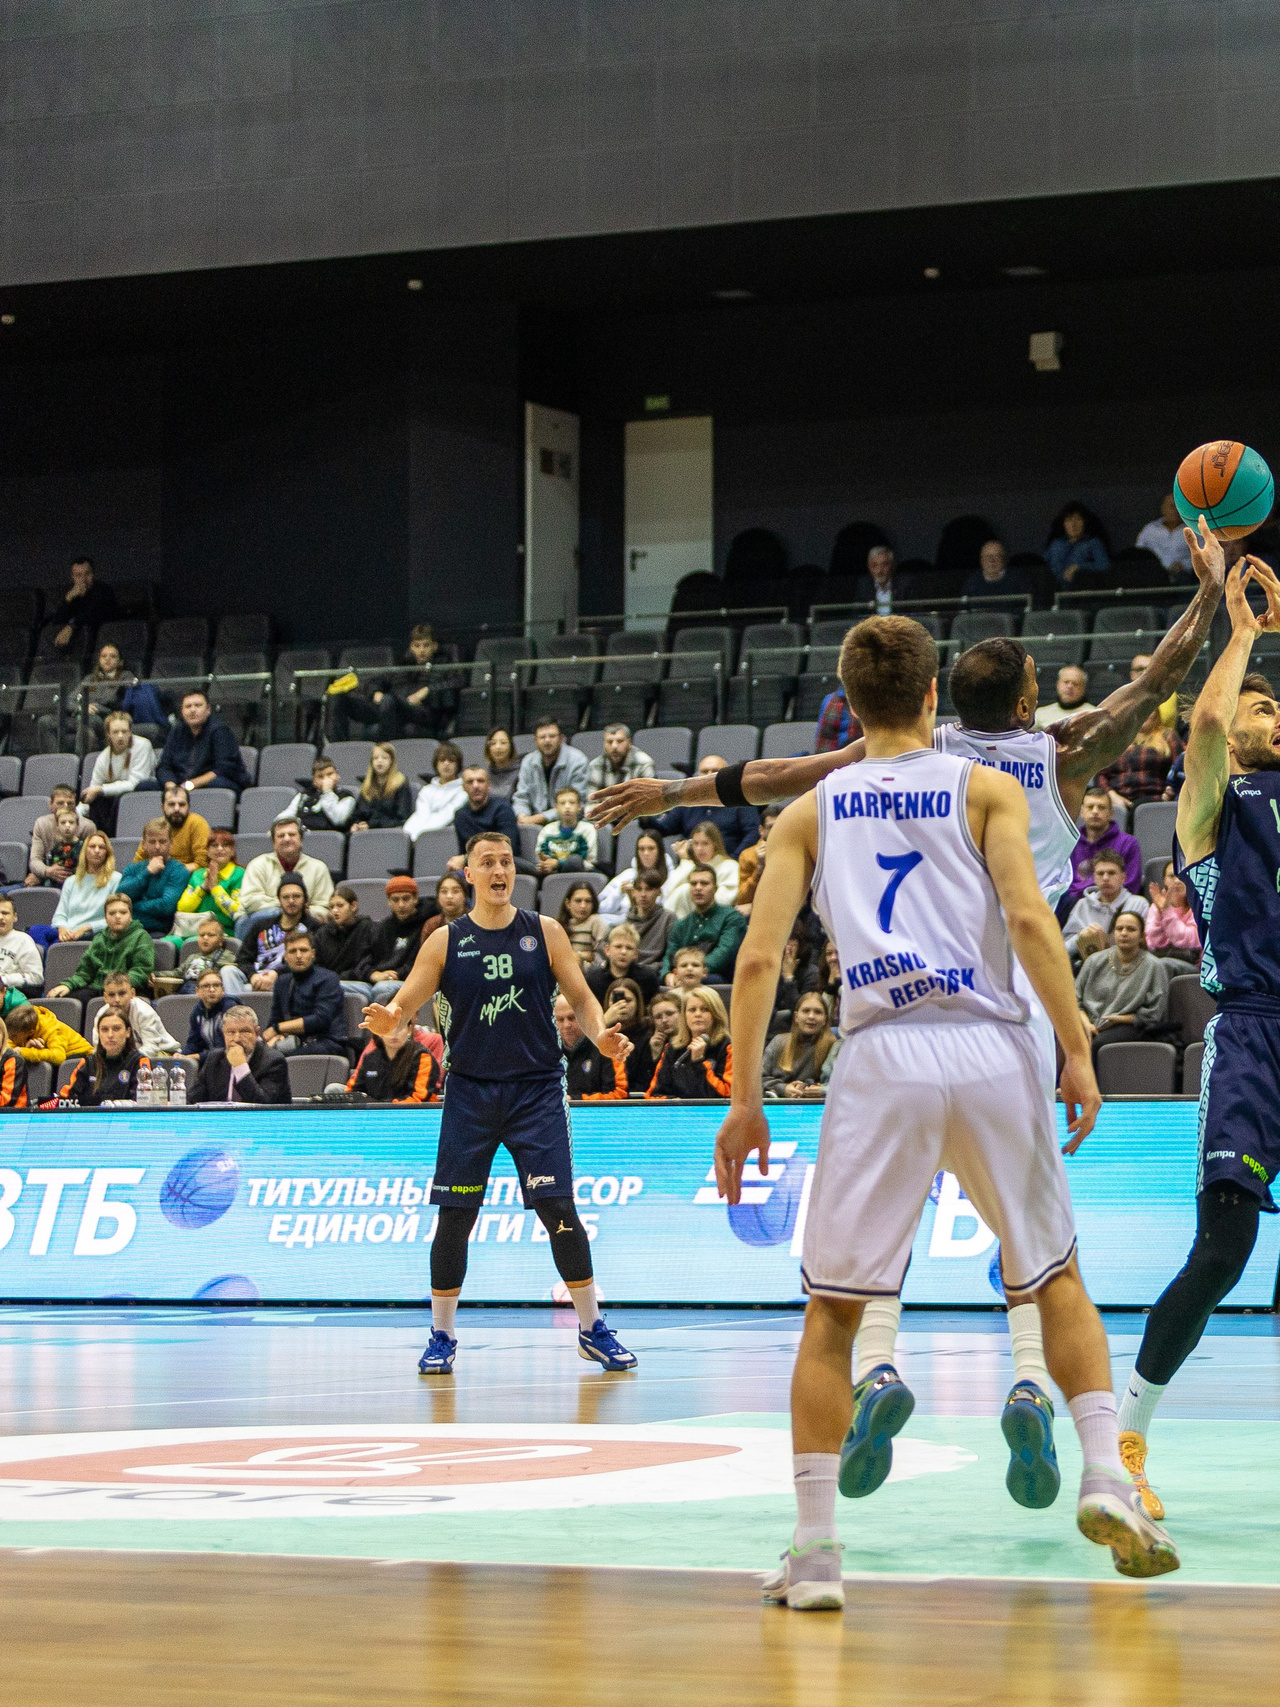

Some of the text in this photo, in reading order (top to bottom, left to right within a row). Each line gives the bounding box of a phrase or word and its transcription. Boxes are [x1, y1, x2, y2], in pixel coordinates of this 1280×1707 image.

[833, 790, 951, 820] KARPENKO
[876, 850, 923, 934] 7
[457, 949, 481, 959] Kempa
[482, 953, 514, 980] 38
[1206, 1150, 1236, 1161] Kempa
[268, 1206, 420, 1247] ЕДИНОЙ
